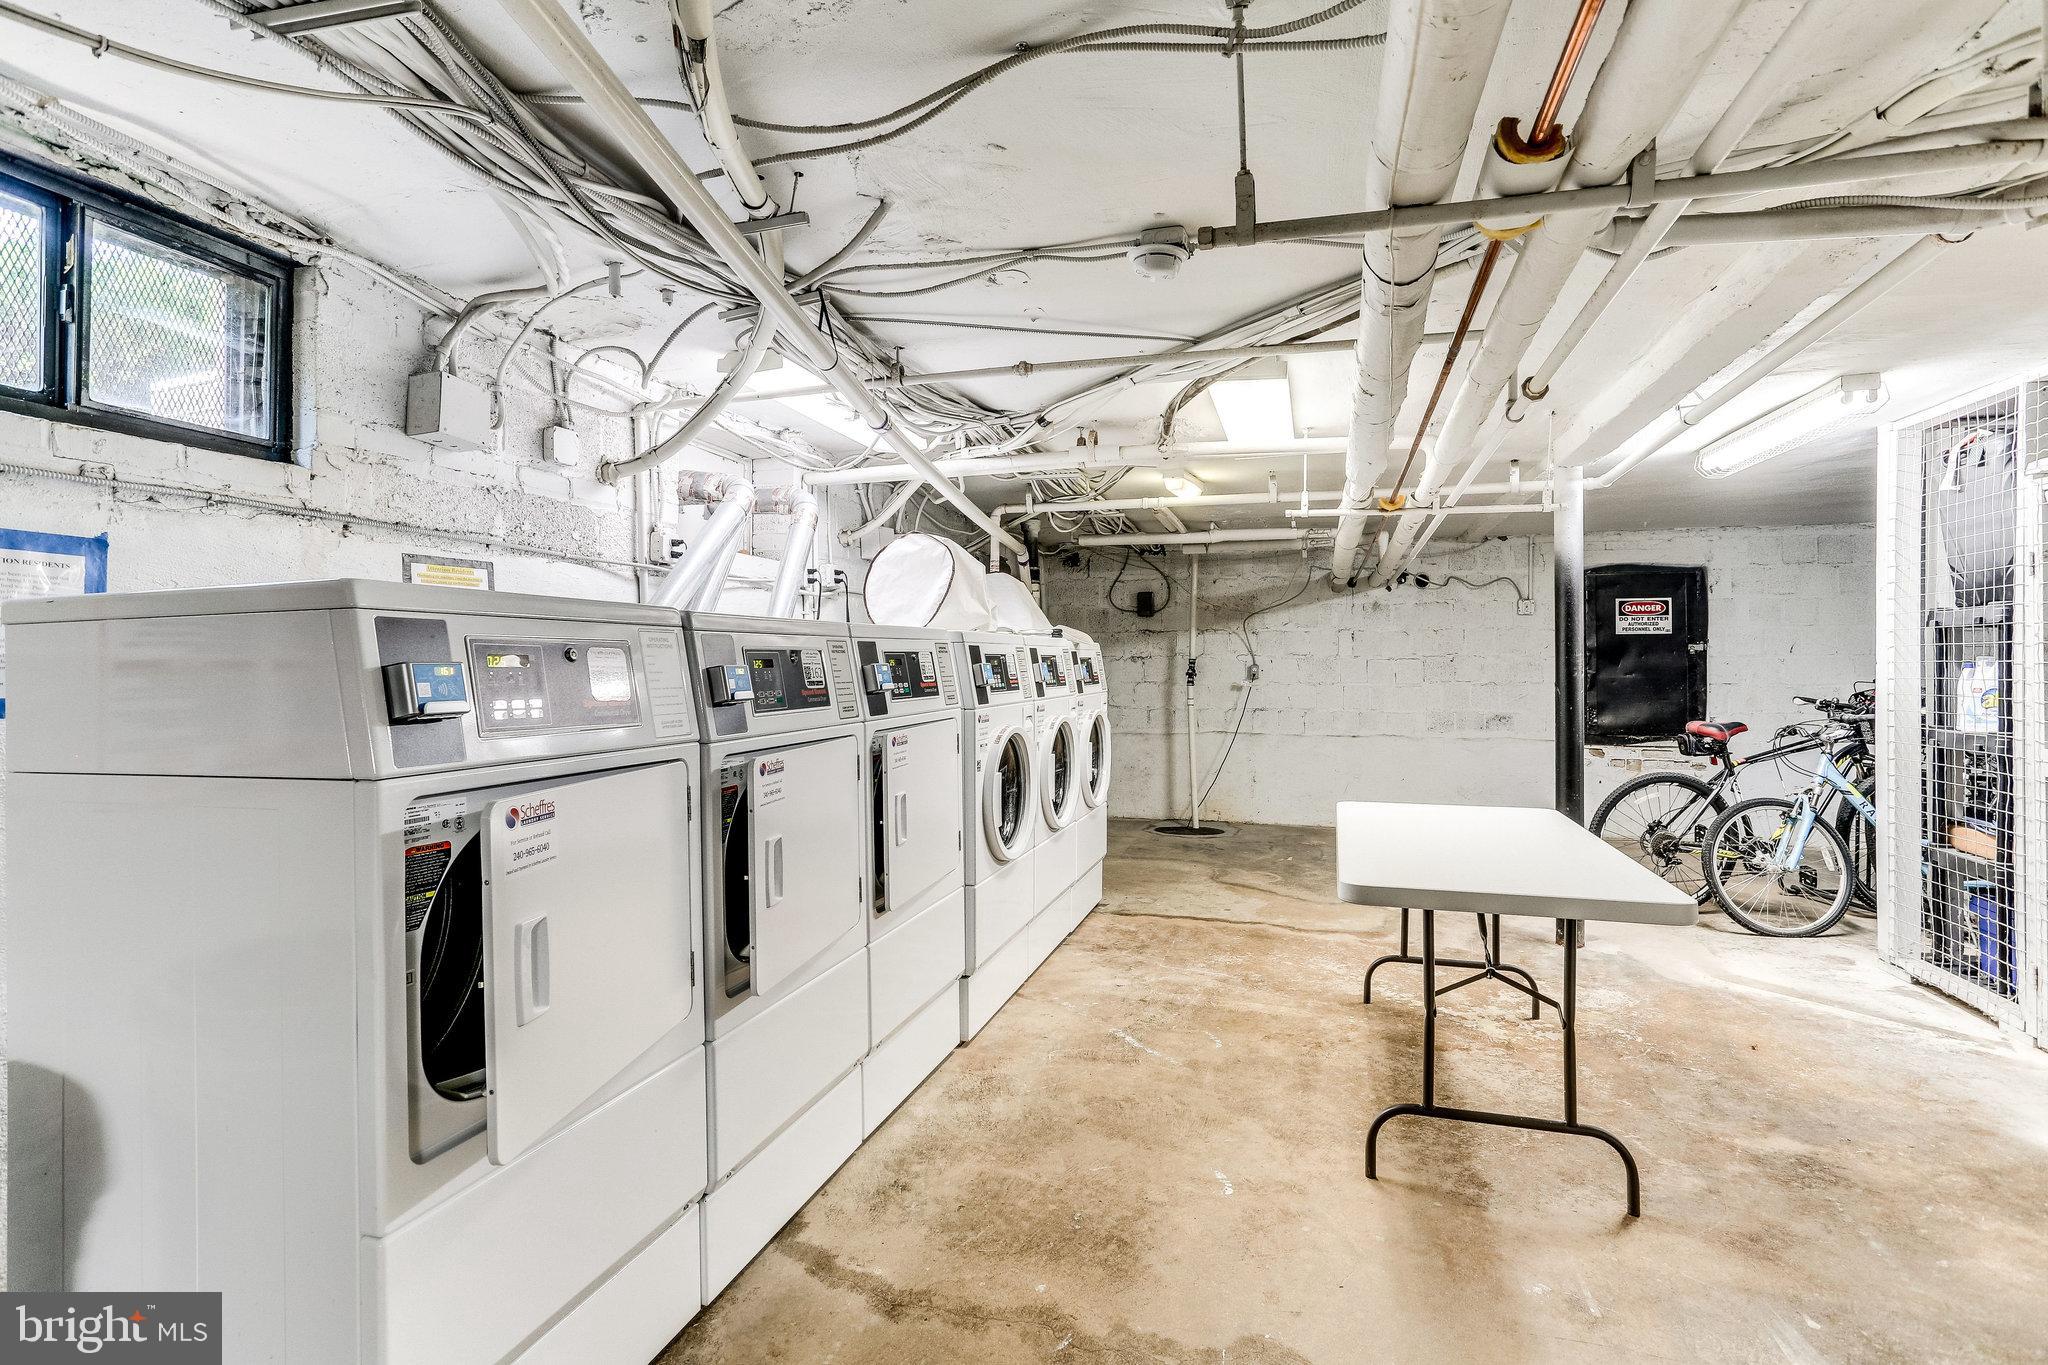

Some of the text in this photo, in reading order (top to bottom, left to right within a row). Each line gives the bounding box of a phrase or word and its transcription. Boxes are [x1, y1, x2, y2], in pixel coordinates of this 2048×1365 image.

[811, 667, 823, 679] 162
[520, 799, 556, 819] Scheffres
[415, 843, 444, 852] WARNING
[513, 842, 550, 861] 240-965-6040
